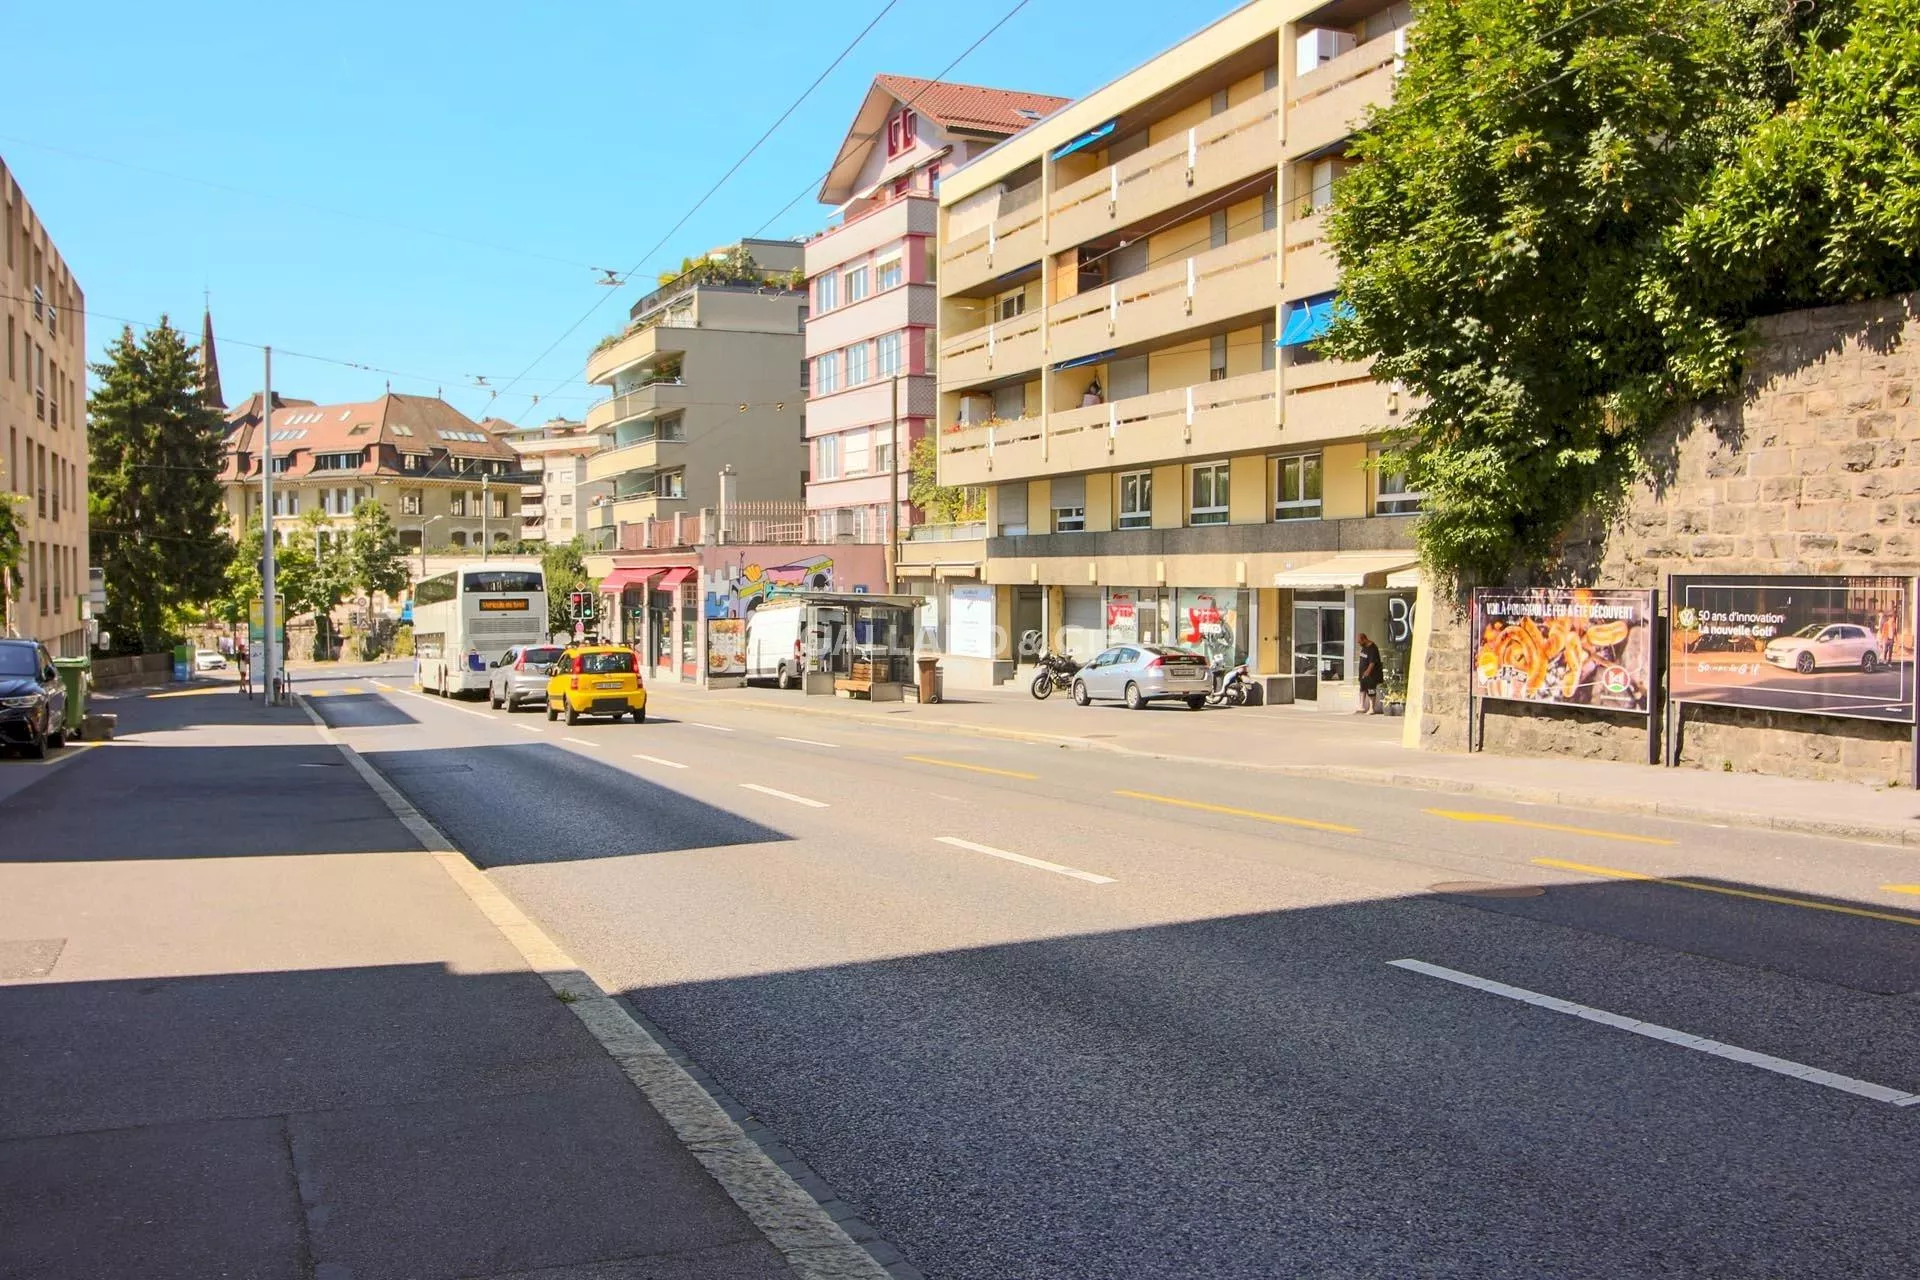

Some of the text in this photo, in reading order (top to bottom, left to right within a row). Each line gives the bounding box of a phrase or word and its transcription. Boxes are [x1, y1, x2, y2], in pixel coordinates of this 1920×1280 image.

[1543, 604, 1552, 617] LE
[1589, 603, 1633, 619] DÉCOUVERT
[1698, 610, 1784, 624] 50 ans d'innovation
[1699, 624, 1774, 637] La nouvelle Golf
